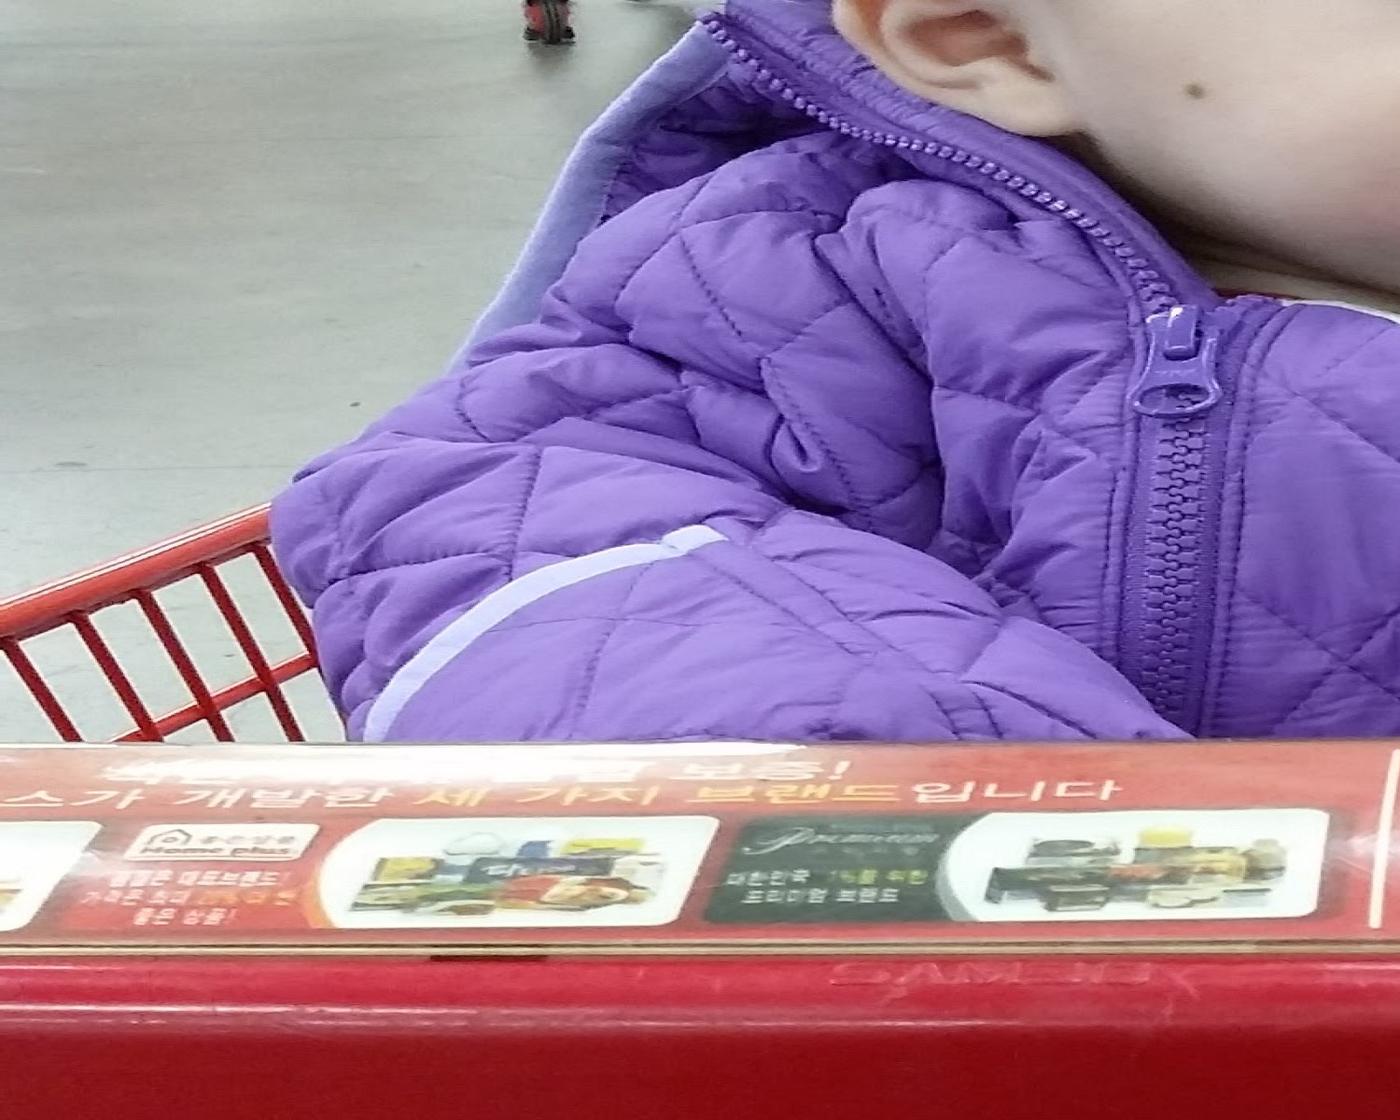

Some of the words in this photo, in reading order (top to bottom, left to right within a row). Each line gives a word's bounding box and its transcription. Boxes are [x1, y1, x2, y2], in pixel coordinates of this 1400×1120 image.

[175, 788, 394, 808] 개발한
[411, 787, 491, 807] 세
[516, 786, 661, 806] 가지
